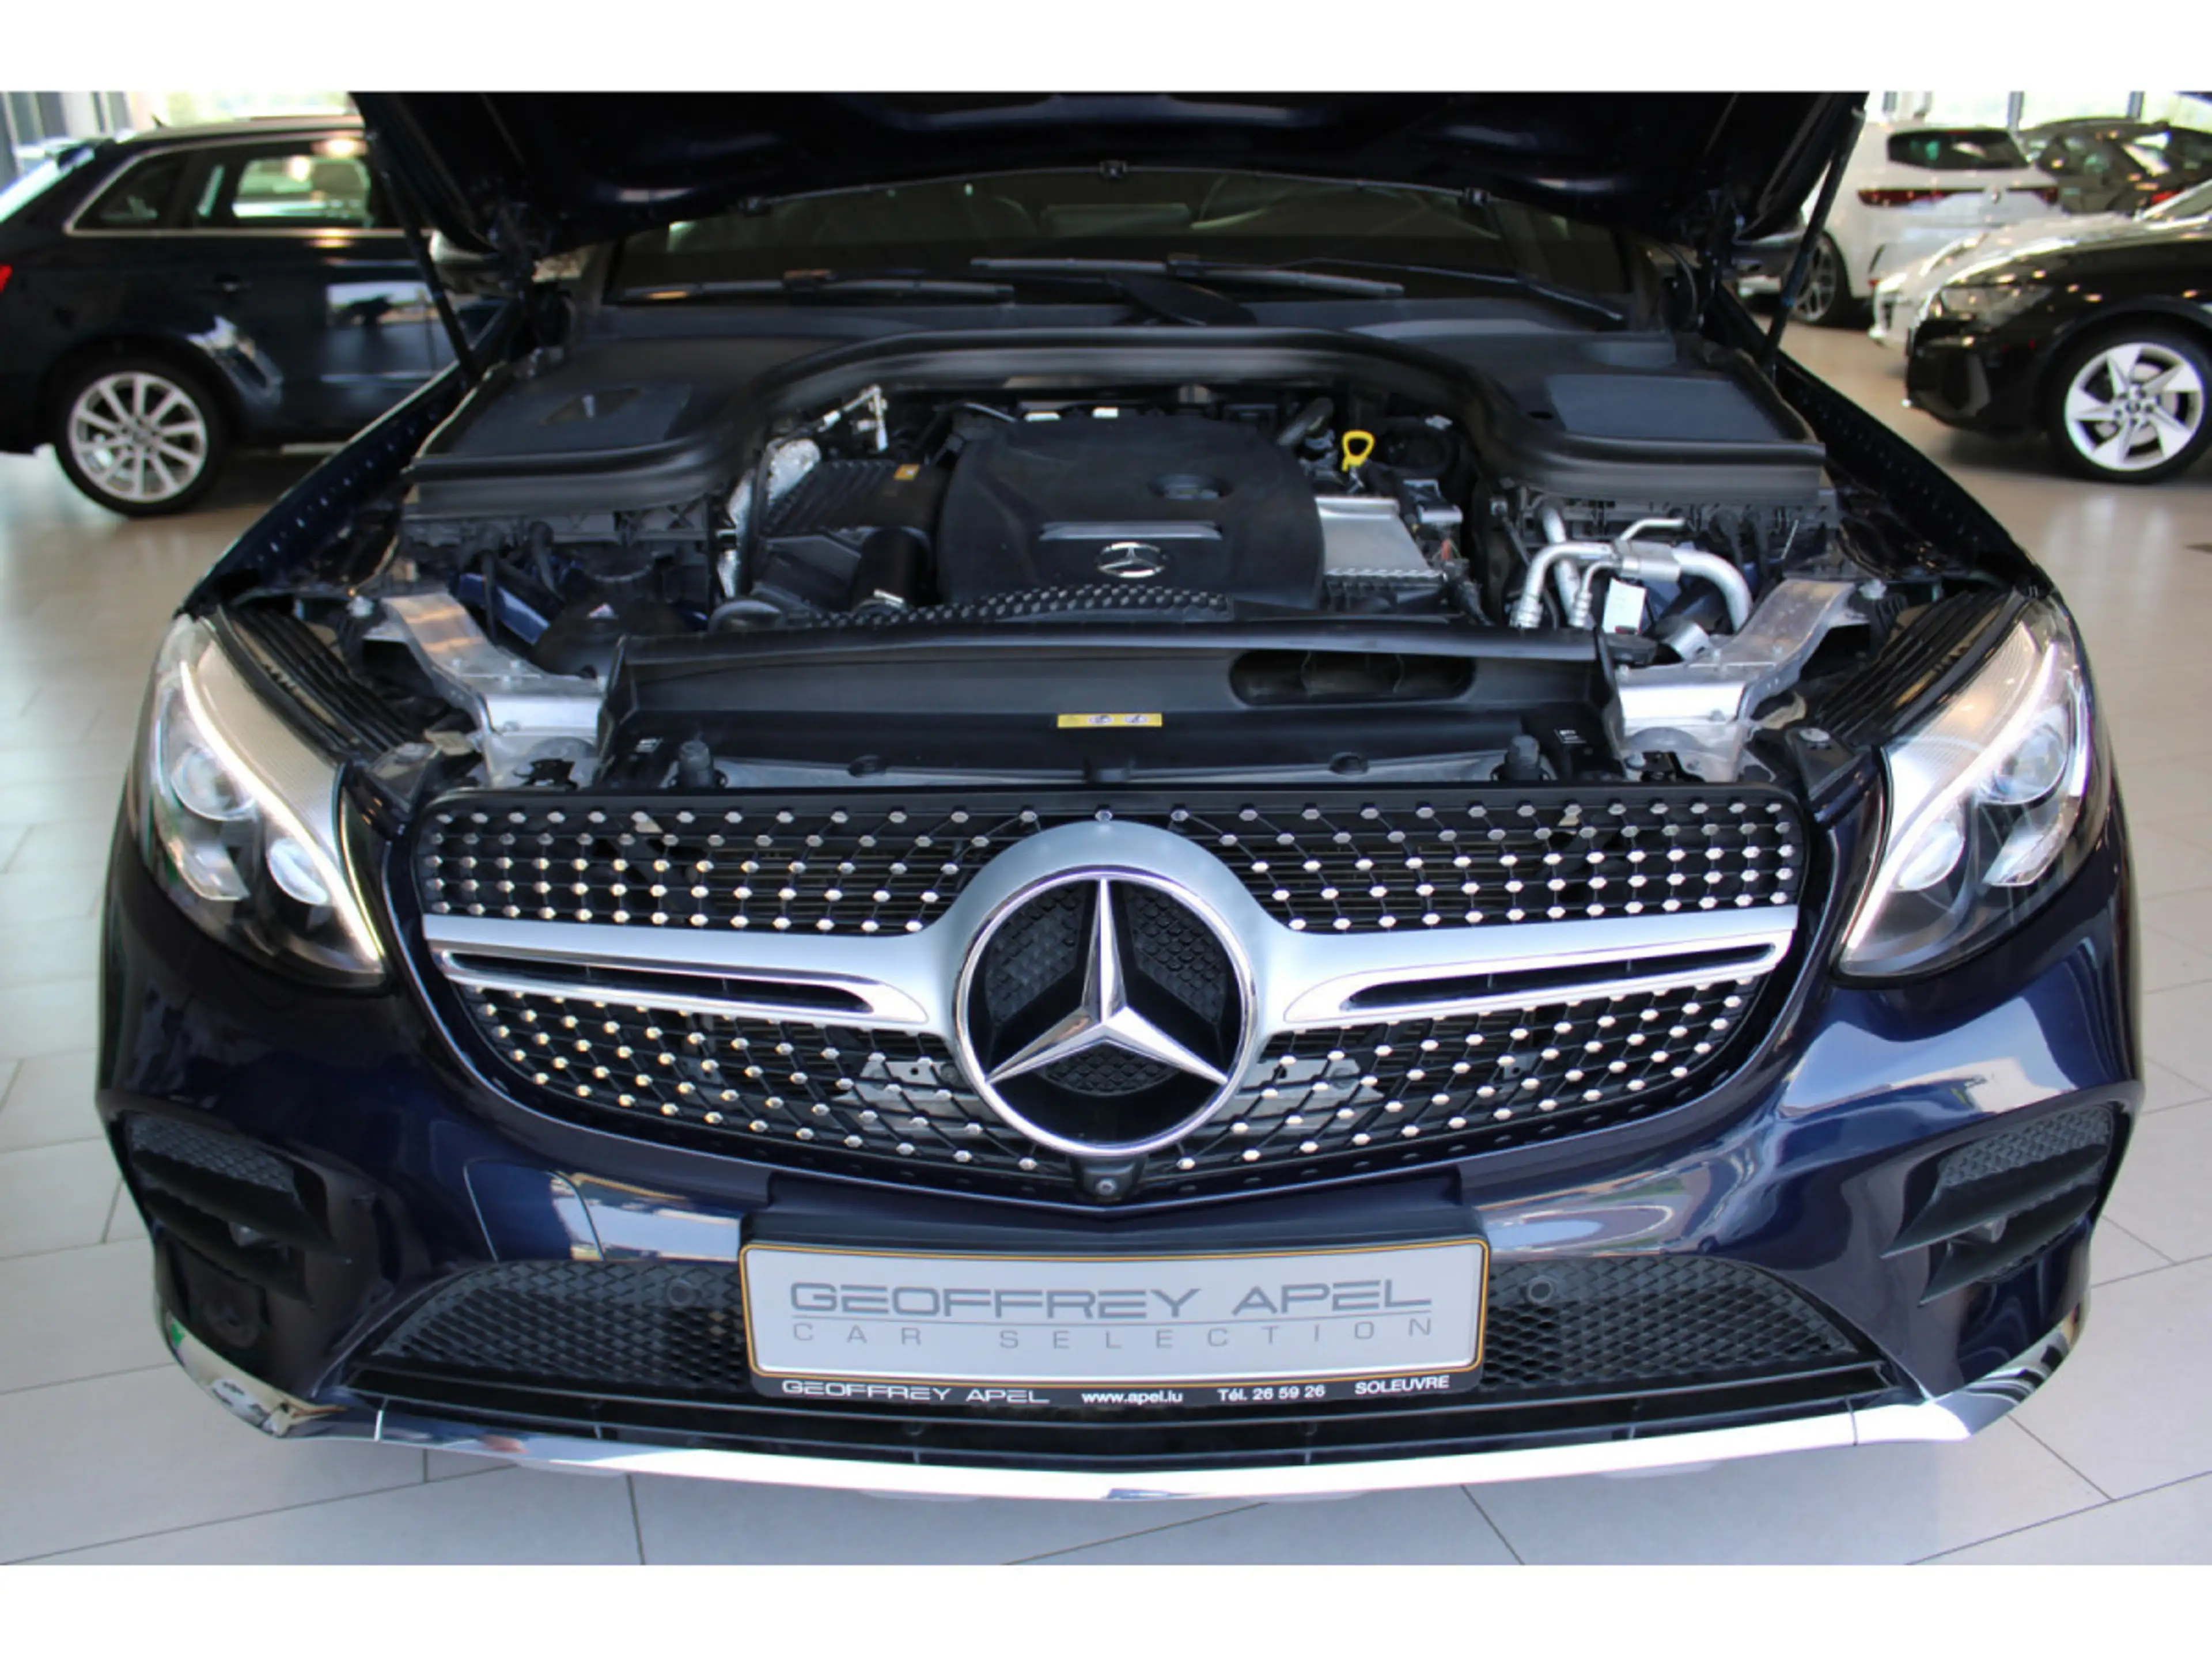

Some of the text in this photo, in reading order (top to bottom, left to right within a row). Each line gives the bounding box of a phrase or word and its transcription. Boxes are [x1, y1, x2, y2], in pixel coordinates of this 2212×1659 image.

[790, 1279, 1432, 1319] GEOFFREY APEL
[793, 1318, 1432, 1349] CAR SELECTION
[782, 1375, 1450, 1406] GEOFFREY APEL www.apel.lu Tél. 26 59 26 SOLEUVRE
